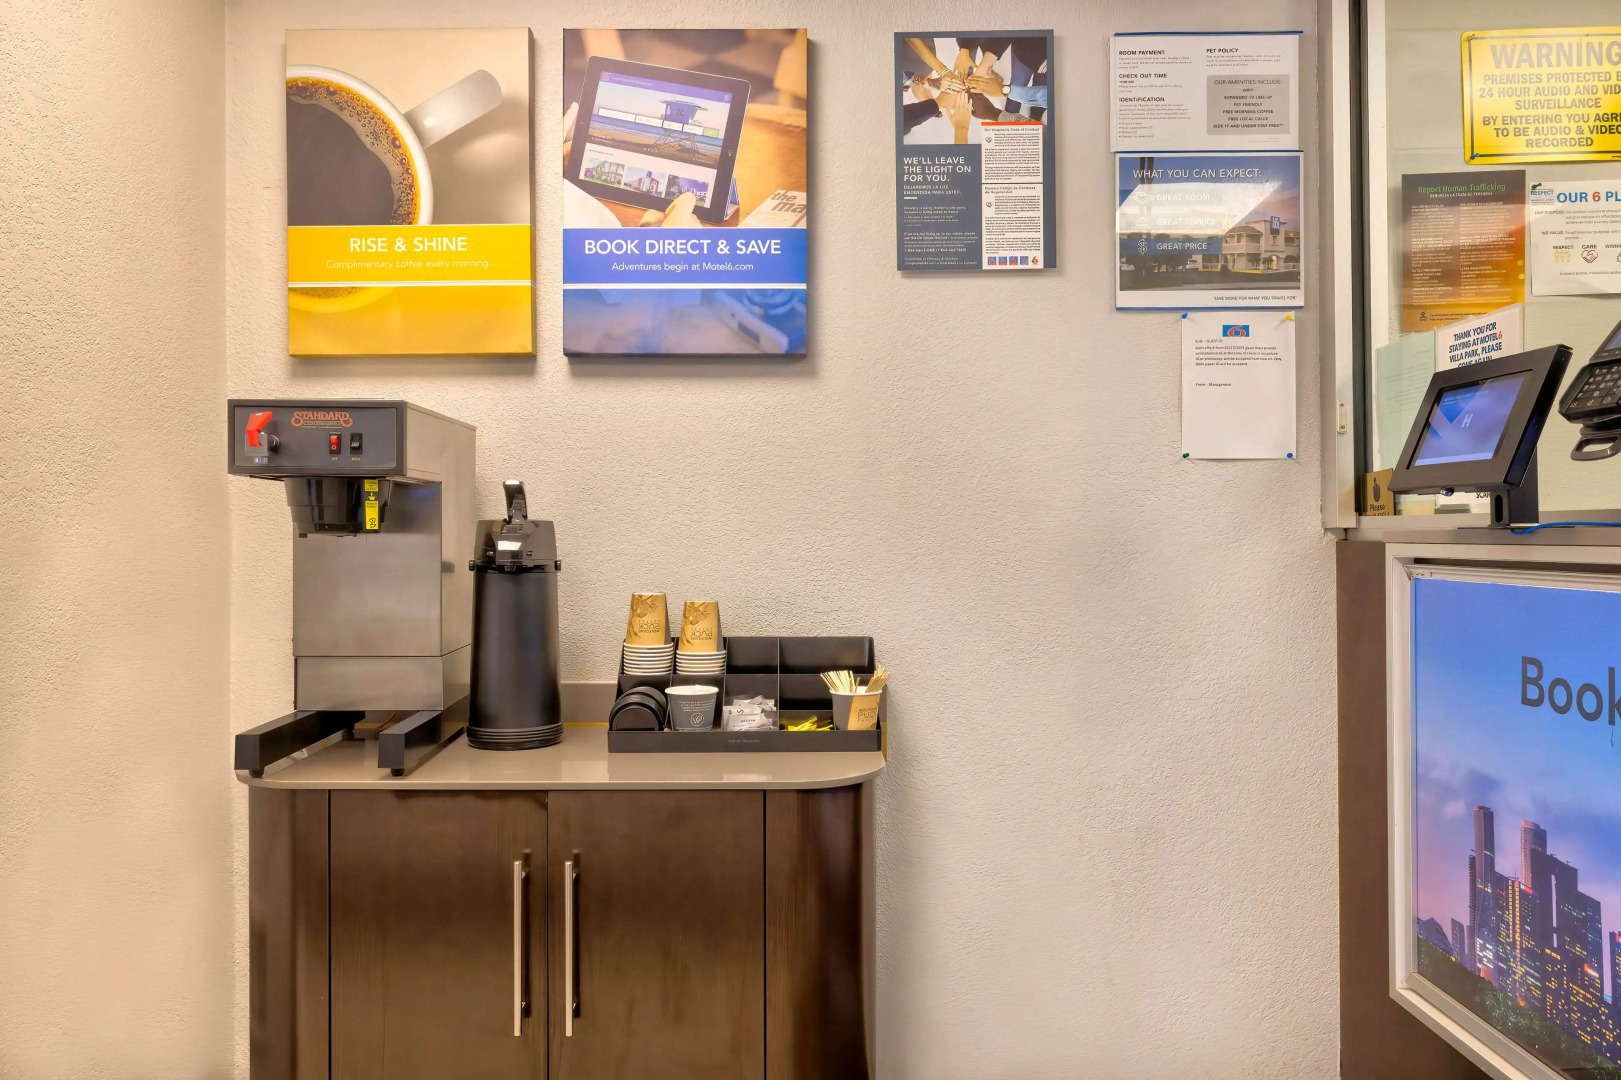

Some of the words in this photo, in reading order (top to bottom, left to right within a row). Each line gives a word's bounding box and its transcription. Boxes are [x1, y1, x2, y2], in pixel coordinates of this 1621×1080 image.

[1490, 41, 1621, 69] WARNING
[1484, 73, 1542, 85] PREMISES
[1546, 71, 1611, 83] PROTECTED
[1479, 87, 1493, 98] 24
[1498, 87, 1530, 97] HOUR
[1534, 86, 1570, 97] AUDIO
[1574, 85, 1598, 95] AND
[1515, 98, 1601, 110] SURVEILLANCE
[1483, 116, 1498, 126] BY
[1501, 114, 1562, 125] ENTERING
[1566, 113, 1590, 123] YOU
[1594, 113, 1621, 122] AGR
[1494, 127, 1509, 137] TO
[1513, 127, 1529, 137] BE
[1533, 126, 1571, 136] AUDIO
[1575, 126, 1585, 135] &
[1526, 137, 1593, 148] RECORDED
[903, 157, 932, 165] WE'LL
[935, 156, 965, 164] LEAVE
[925, 165, 953, 173] LIGHT
[956, 165, 972, 173] ON
[1133, 169, 1164, 178] WHAT
[1167, 169, 1189, 178] YOU
[1193, 169, 1216, 178] CAN
[1219, 168, 1262, 178] EXPECT:
[904, 174, 923, 182] FOR
[926, 174, 950, 182] YOU.
[1419, 186, 1441, 194] Report
[1470, 183, 1506, 191] Trafficking
[1185, 193, 1210, 201] ROOM
[1557, 192, 1588, 203] OUR
[1592, 191, 1601, 202] 6
[1157, 218, 1182, 226] GREAT
[350, 238, 387, 252] RISE
[394, 238, 407, 252] &
[413, 237, 467, 251] SHINE
[585, 239, 639, 254] BOOK
[646, 239, 711, 254] DIRECT
[717, 239, 730, 254] &
[736, 239, 781, 254] SAVE
[1157, 242, 1182, 250] GREAT
[326, 260, 392, 270] Complimentary
[396, 259, 423, 268] coffee
[426, 260, 450, 269] every
[452, 260, 490, 270] morning.
[612, 262, 662, 271] Adventures
[664, 262, 688, 272] begin
[691, 262, 700, 271] at
[702, 262, 754, 271] Motel6.com
[1454, 329, 1471, 341] THANK
[1473, 326, 1485, 336] YOU
[1486, 322, 1497, 332] FOR
[1449, 340, 1471, 353] STAYING
[1472, 337, 1480, 347] AT
[1449, 353, 1464, 363] VILLA
[1465, 349, 1480, 359] PARK,
[1481, 342, 1502, 354] PLEASE
[291, 411, 353, 428] STANDARD
[1521, 656, 1621, 726] Book
